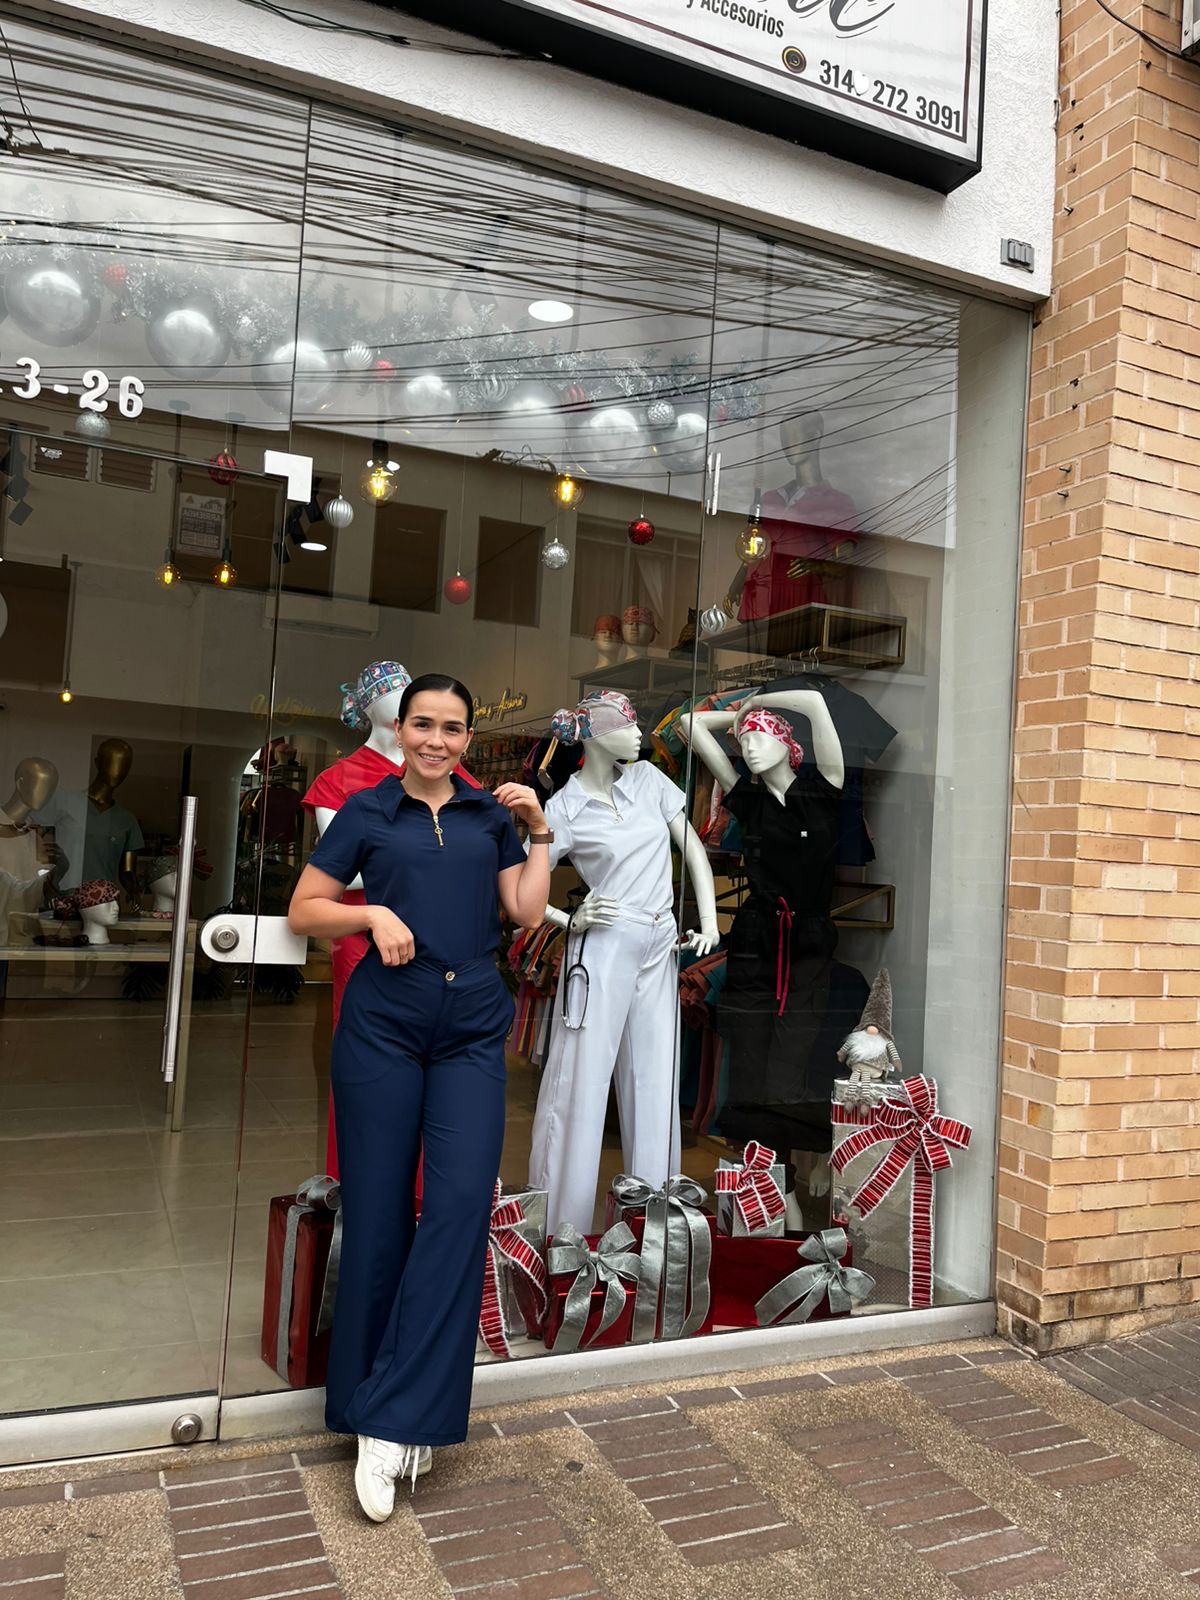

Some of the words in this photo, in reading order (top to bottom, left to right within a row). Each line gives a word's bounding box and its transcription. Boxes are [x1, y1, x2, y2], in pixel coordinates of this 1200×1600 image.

[819, 59, 855, 93] 314
[872, 80, 908, 113] 272
[915, 96, 960, 133] 3091
[0, 357, 145, 418] 3-26
